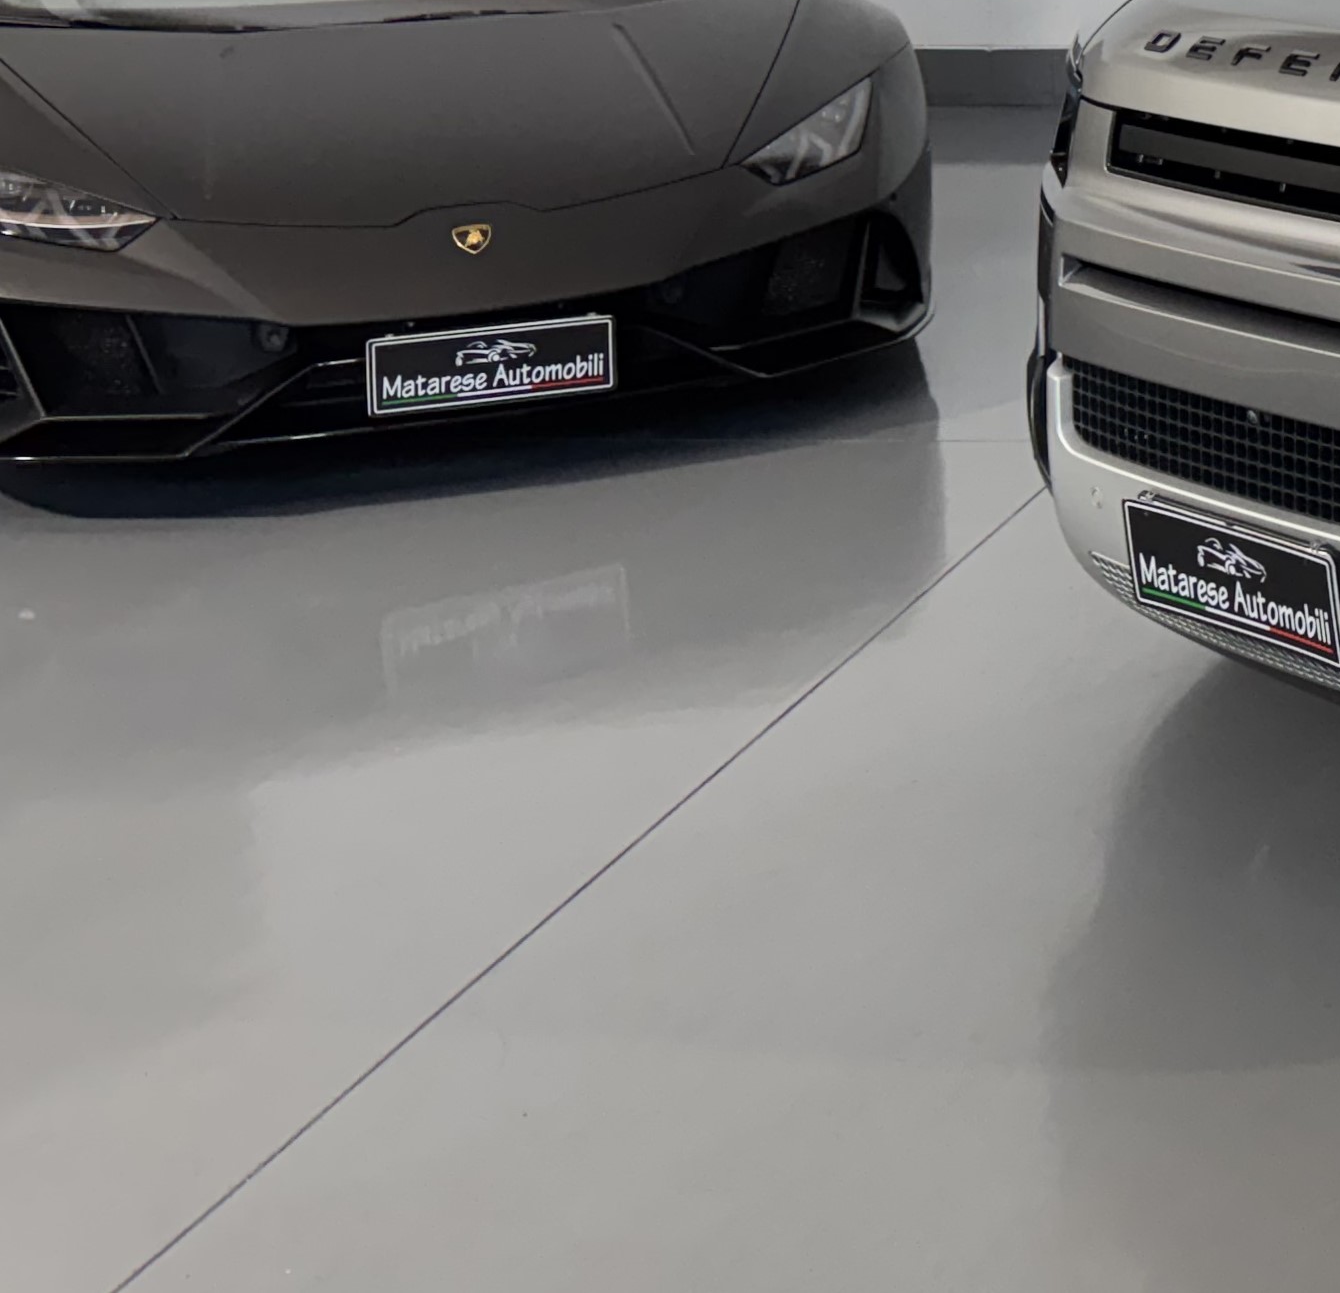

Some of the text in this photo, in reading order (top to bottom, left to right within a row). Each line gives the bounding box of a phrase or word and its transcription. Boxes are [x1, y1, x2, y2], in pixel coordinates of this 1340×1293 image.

[381, 352, 605, 399] Matarese Automobili
[1138, 552, 1332, 646] Matarese Automobili
